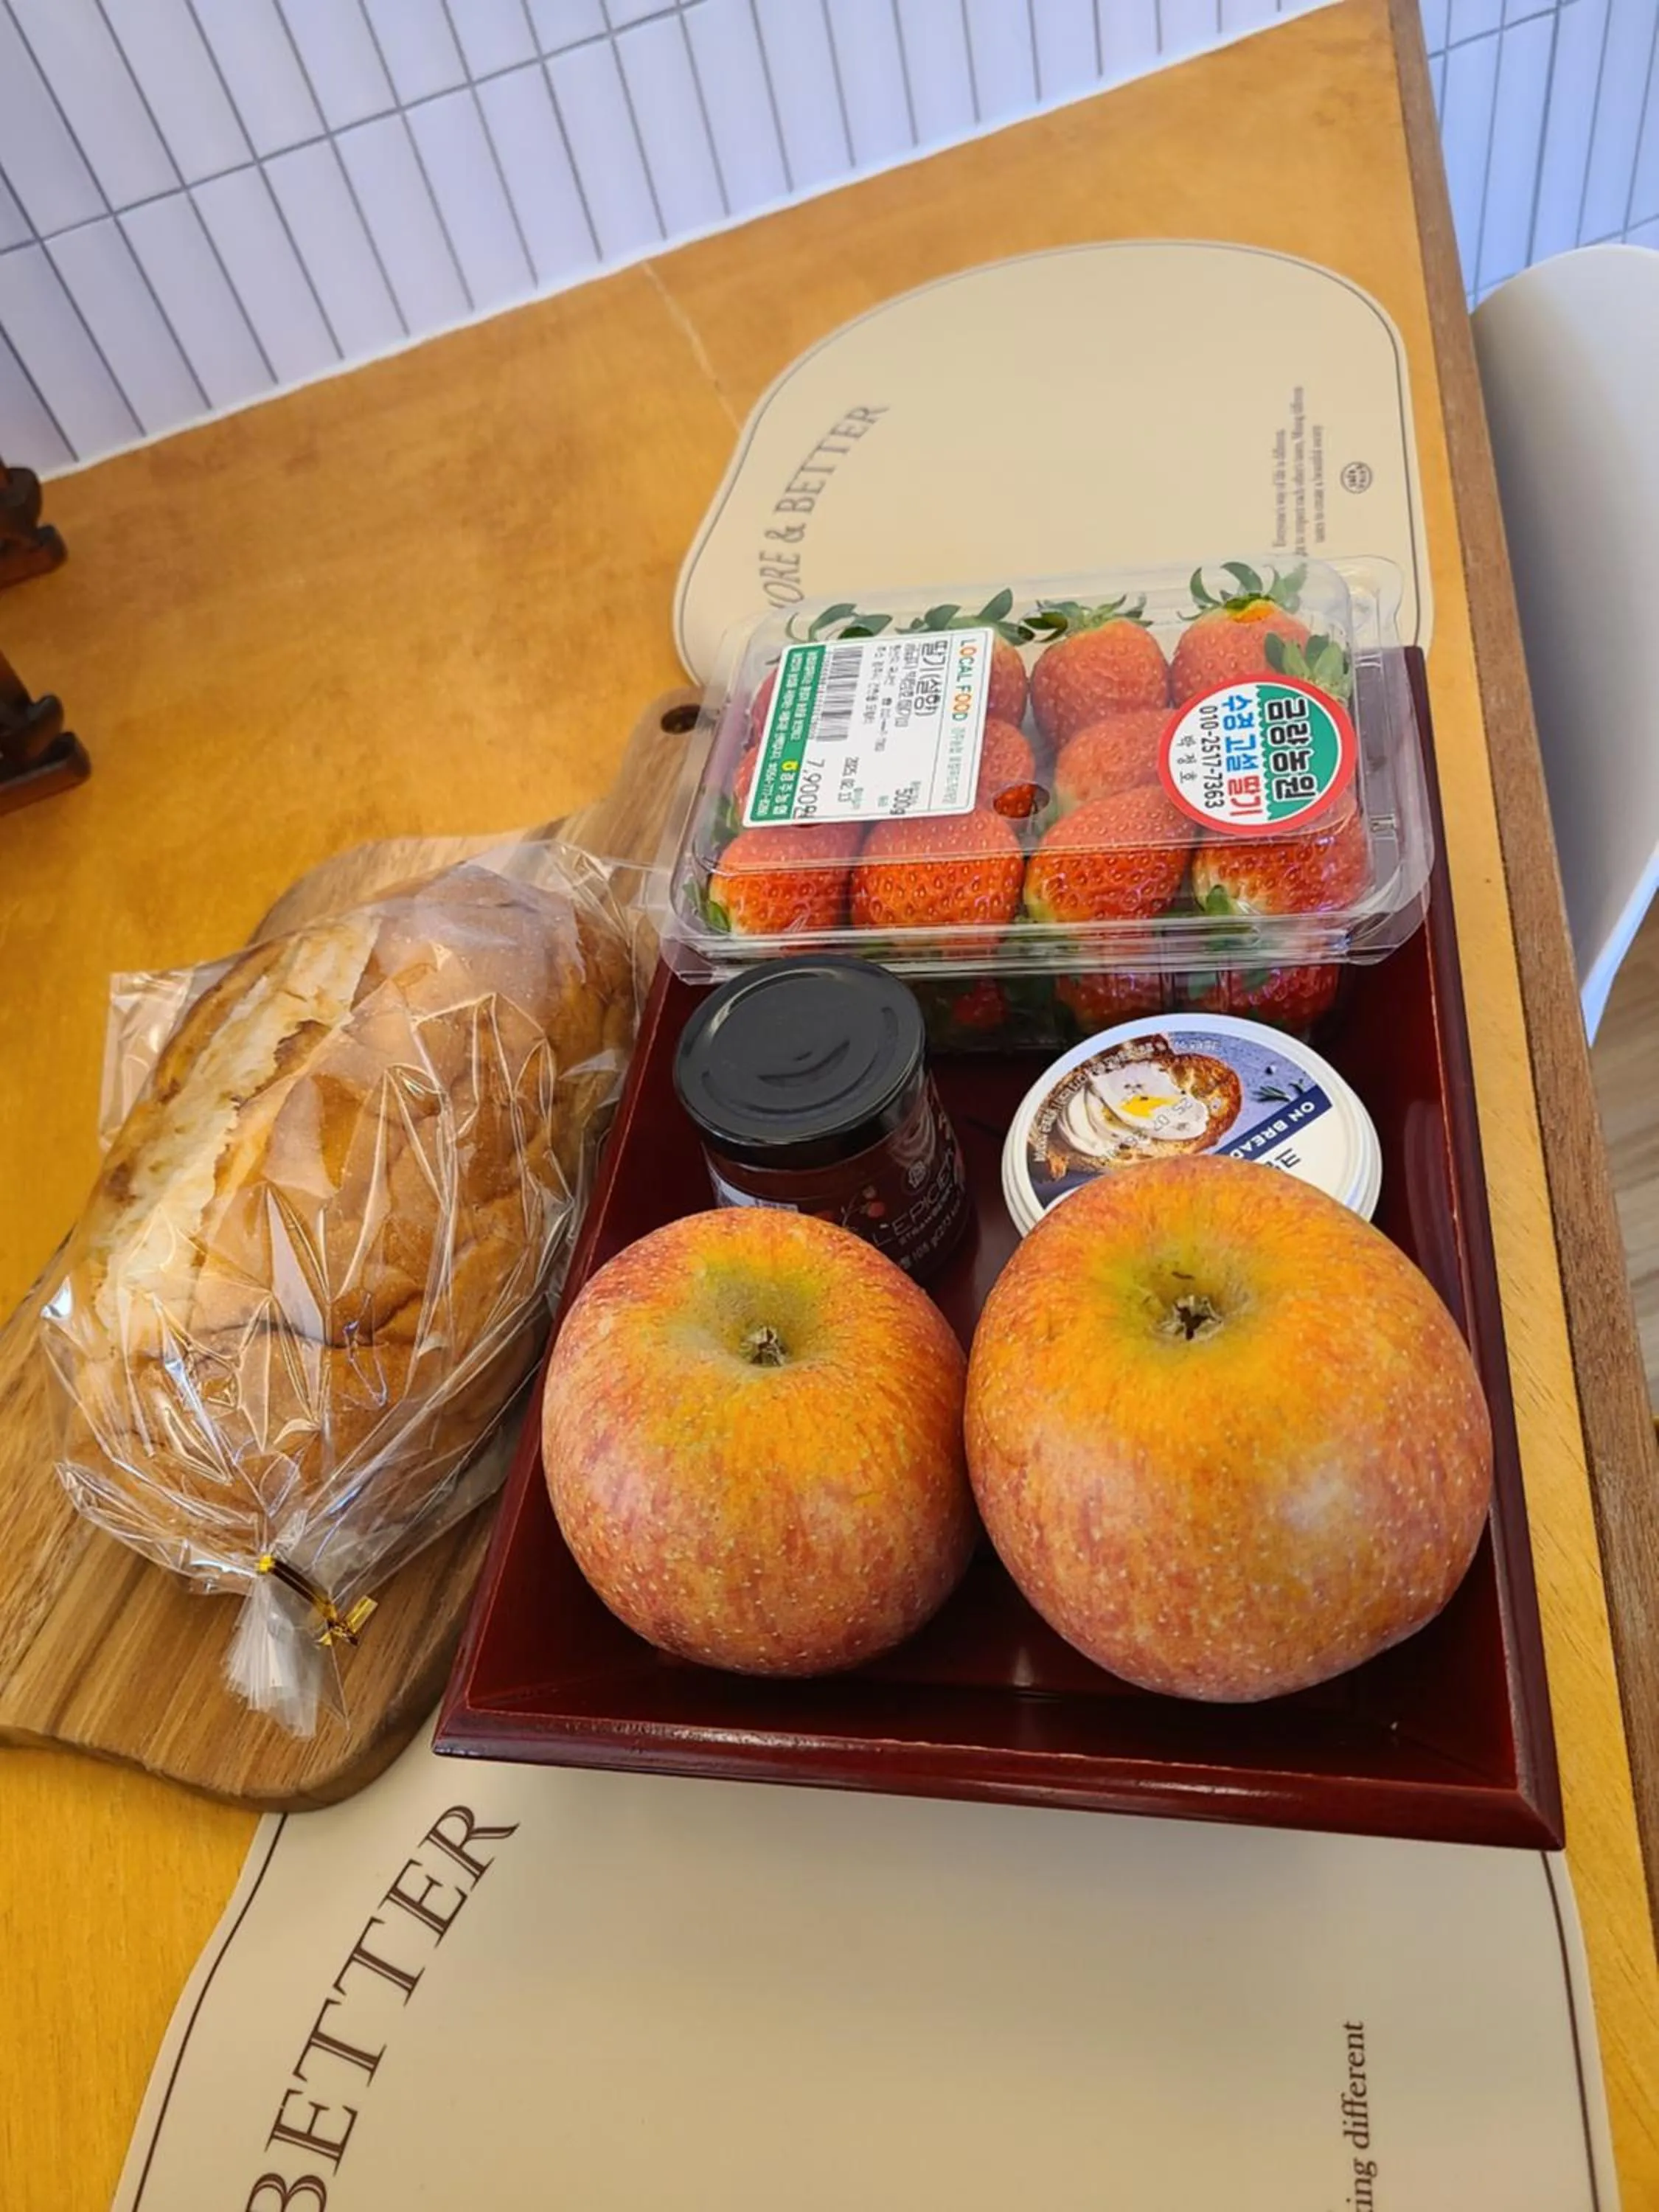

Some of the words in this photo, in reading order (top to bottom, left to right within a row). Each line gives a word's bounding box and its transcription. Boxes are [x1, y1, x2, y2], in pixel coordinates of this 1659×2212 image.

[773, 406, 889, 515] BETTER
[764, 523, 807, 544] &
[758, 552, 804, 609] ORE
[911, 639, 947, 717] 딸기(설향)
[955, 638, 977, 682] LOCAL
[950, 684, 972, 722] FOOD
[1198, 705, 1224, 809] 010-2517-7363
[791, 759, 826, 819] 7,900원
[890, 787, 912, 815] 500g
[1226, 774, 1262, 816] 딸기
[1287, 1100, 1315, 1121] ON
[1228, 1116, 1287, 1159] BREAD
[246, 1804, 521, 2212] BETTER
[1340, 2021, 1371, 2149] different
